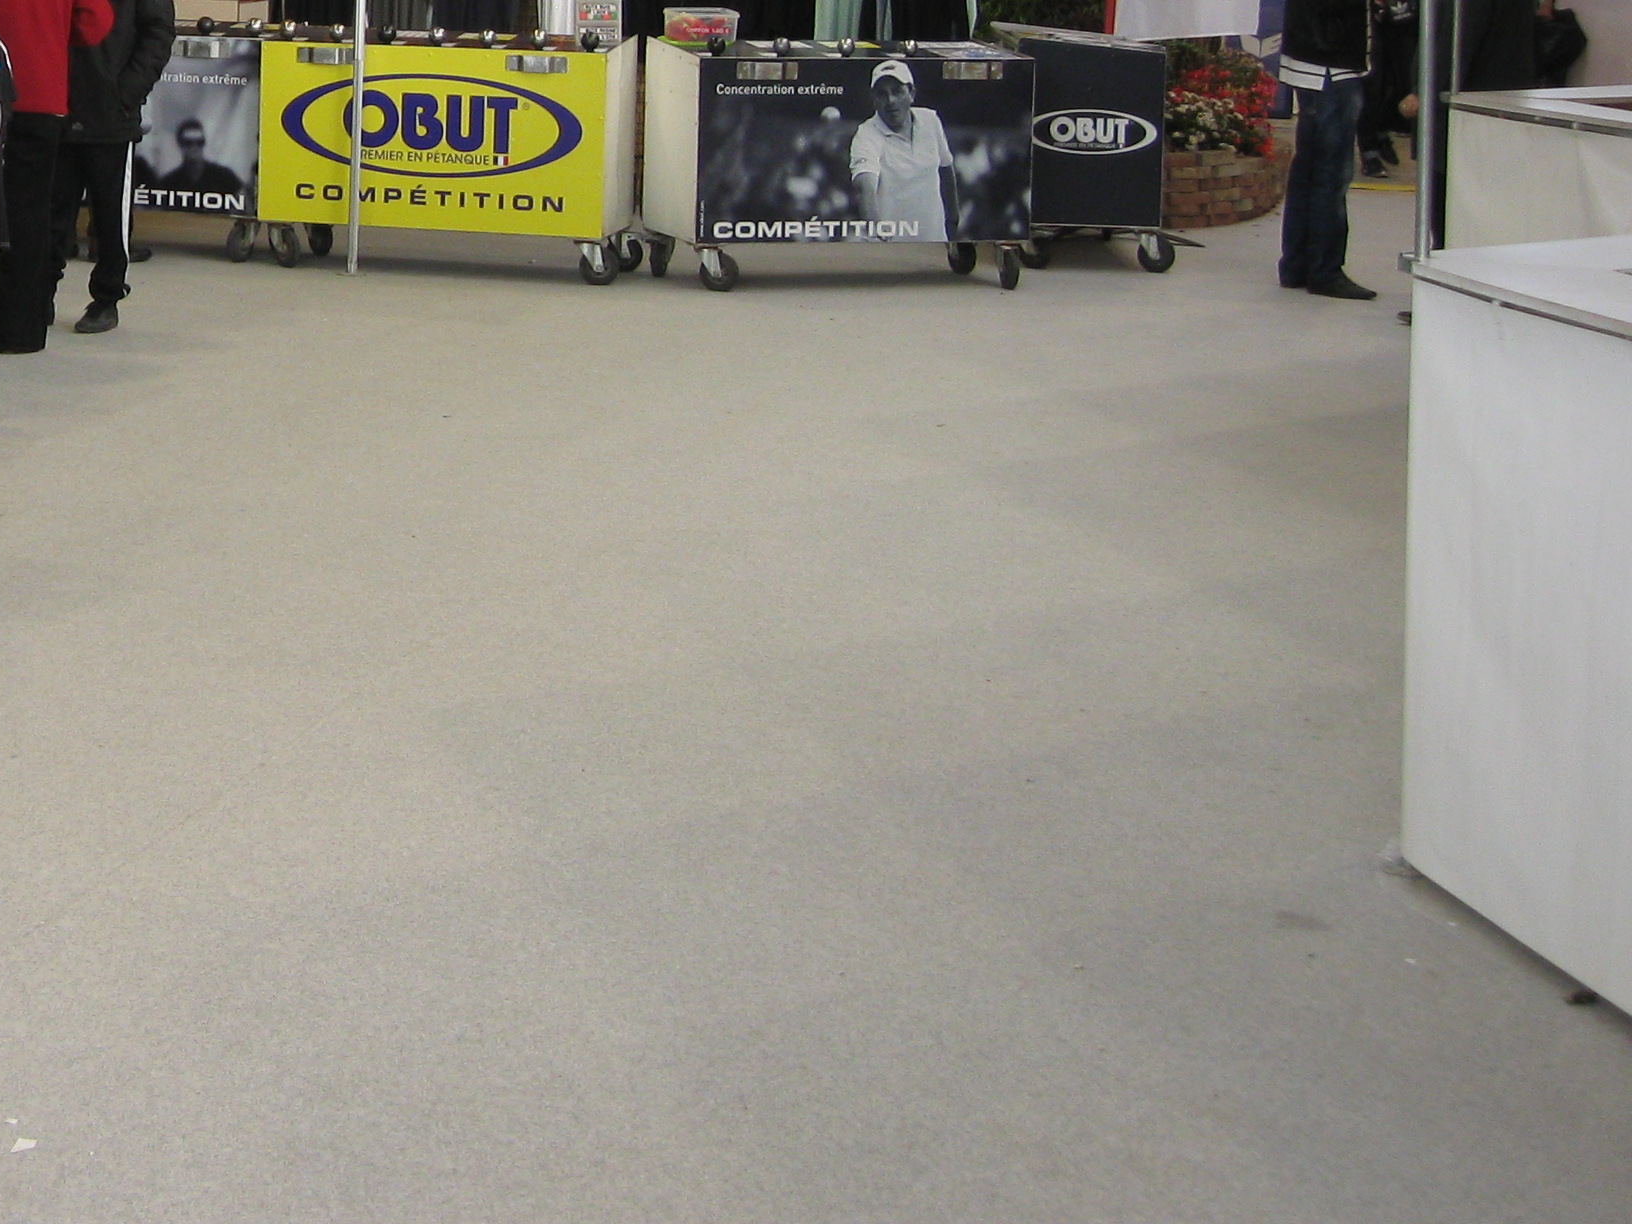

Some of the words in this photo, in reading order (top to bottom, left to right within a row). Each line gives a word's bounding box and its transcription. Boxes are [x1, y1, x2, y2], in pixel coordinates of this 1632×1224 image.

[202, 74, 248, 87] extrême
[716, 83, 795, 95] Concentration
[797, 83, 844, 95] extrême
[342, 89, 519, 155] OBUT
[1049, 116, 1129, 144] OBUT
[359, 148, 403, 162] REMIER
[407, 151, 423, 163] EN
[426, 149, 490, 166] PÉTANQUE
[295, 183, 565, 214] COMPÉTITION
[713, 216, 919, 239] COMPÉTITION
